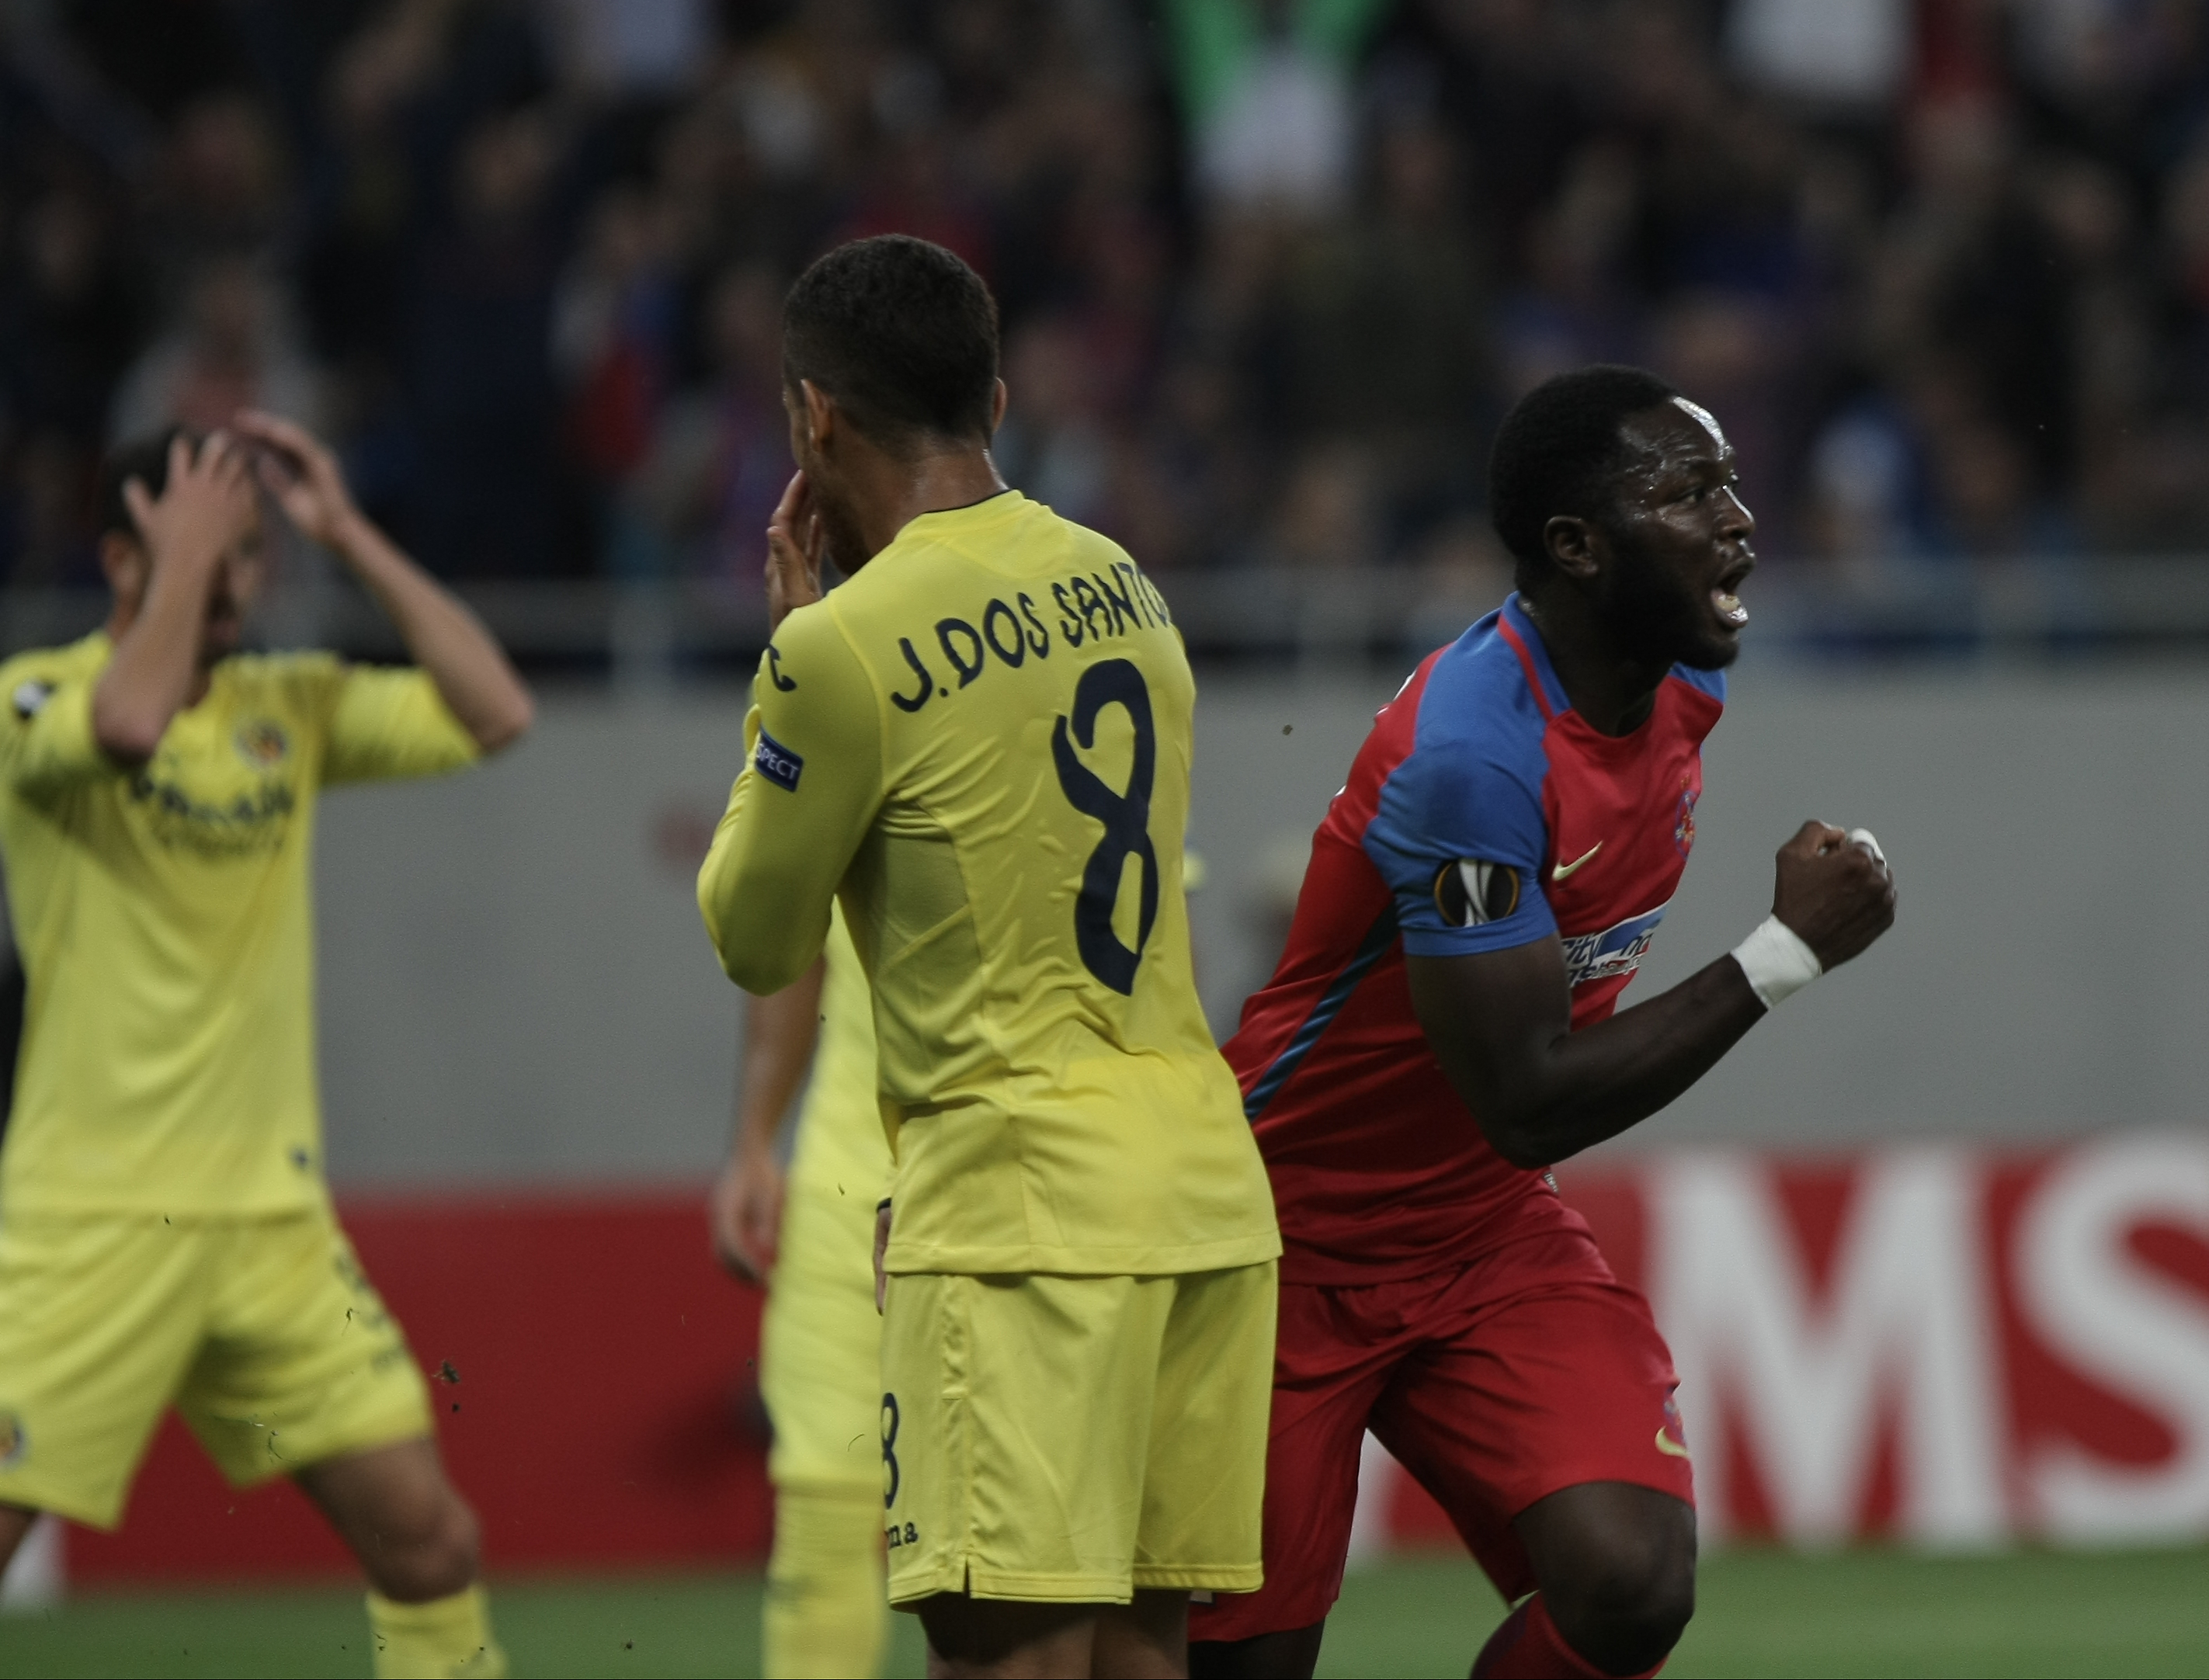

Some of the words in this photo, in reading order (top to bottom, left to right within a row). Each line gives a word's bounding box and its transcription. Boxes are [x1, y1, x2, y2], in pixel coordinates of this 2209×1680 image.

[890, 592, 1050, 713] J.DOS
[1051, 561, 1169, 648] SANTO
[755, 742, 799, 780] SPECT
[1051, 658, 1159, 997] 8
[1634, 1130, 2209, 1557] MS
